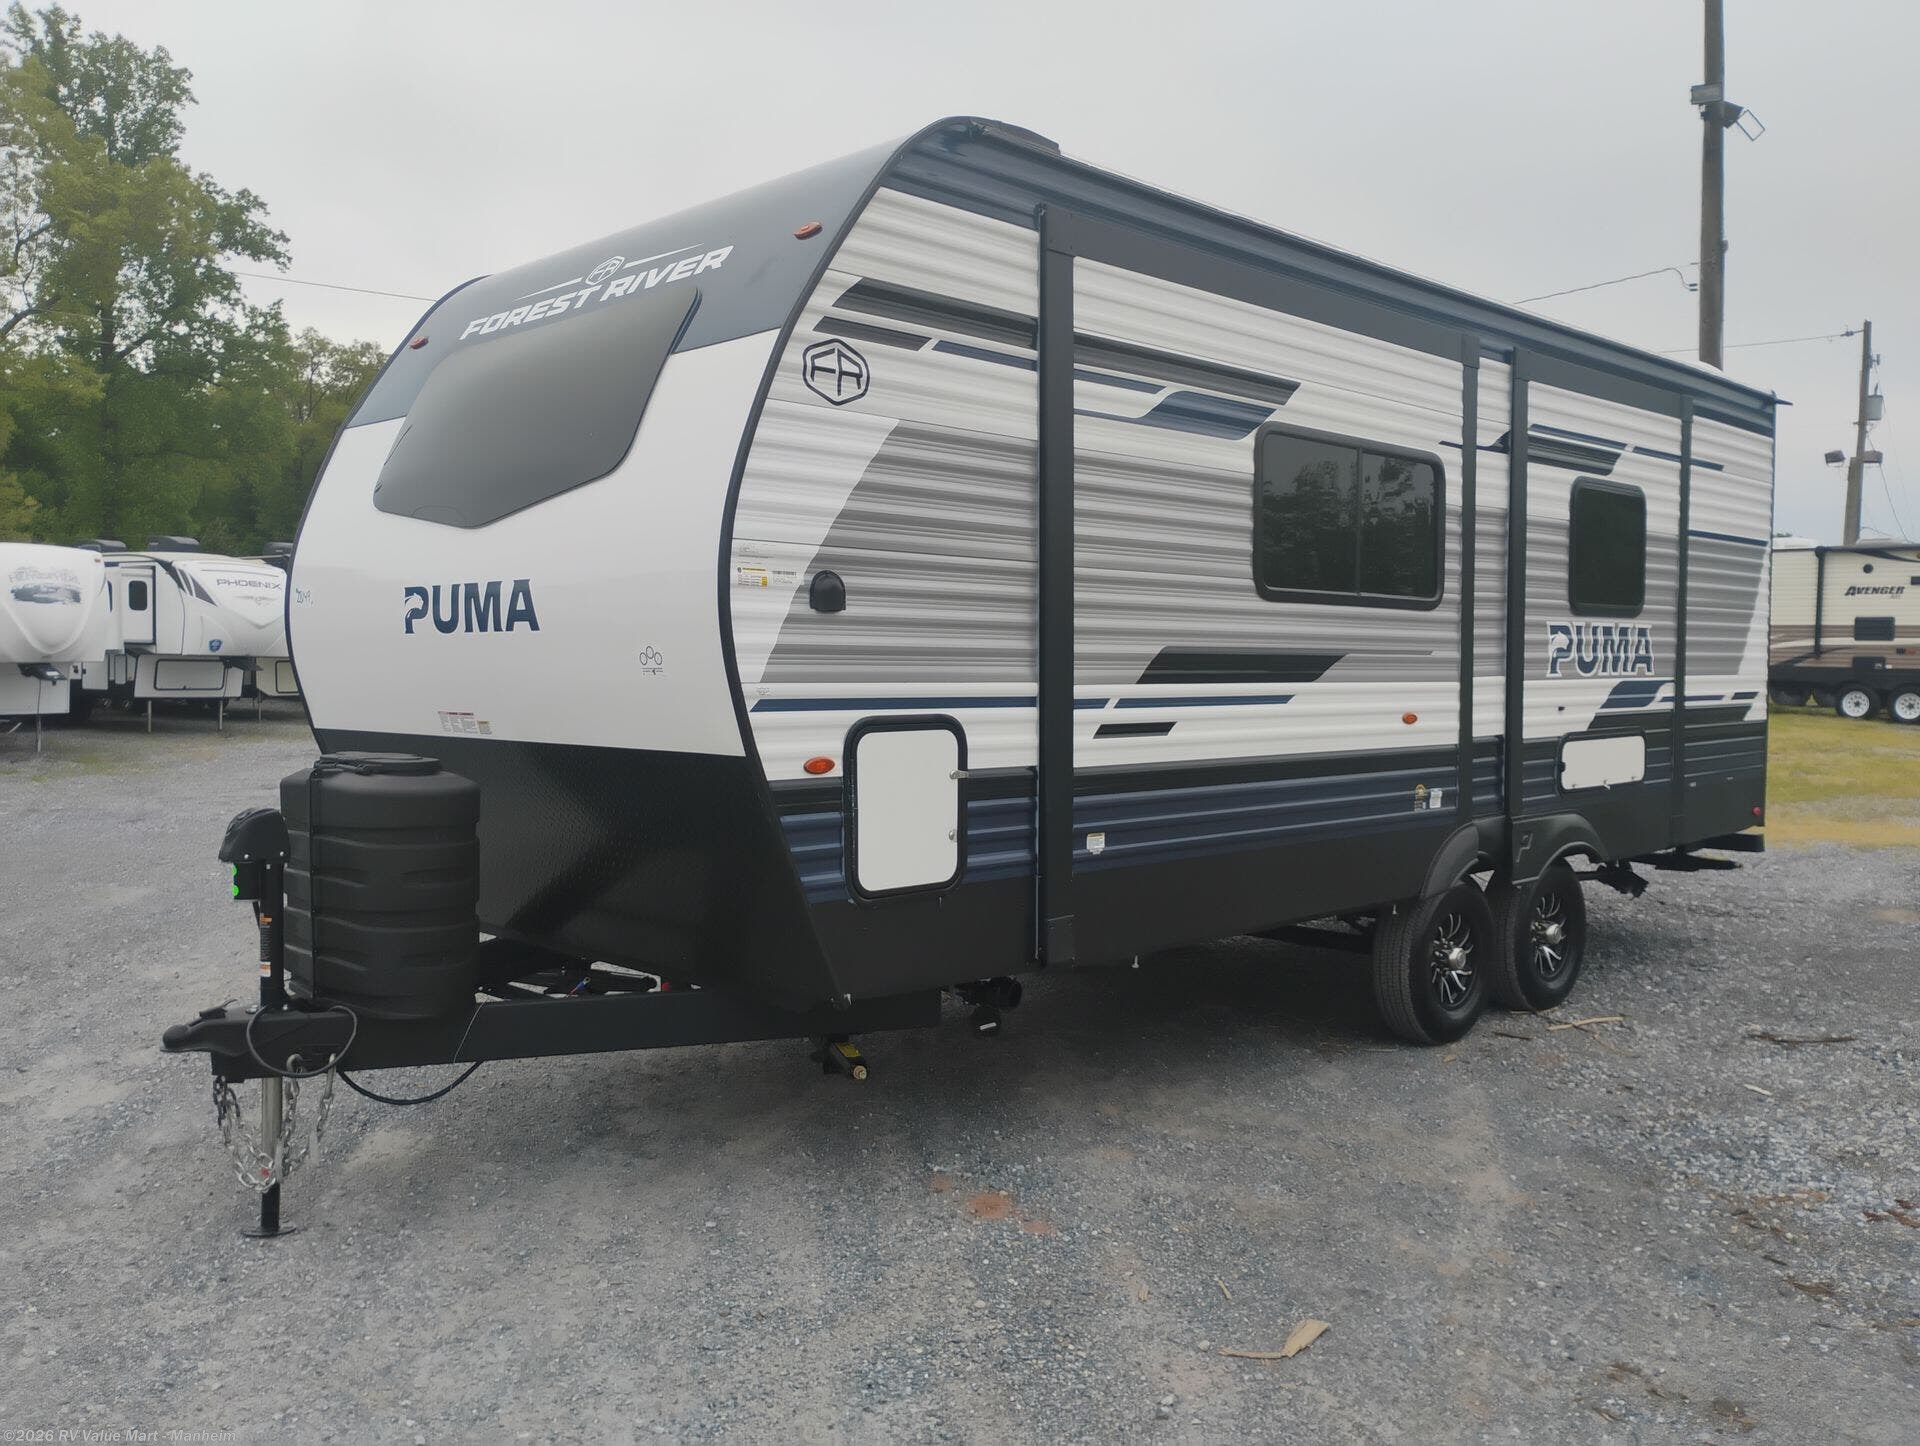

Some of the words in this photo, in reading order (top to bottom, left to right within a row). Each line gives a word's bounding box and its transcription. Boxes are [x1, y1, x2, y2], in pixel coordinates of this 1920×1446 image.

[458, 285, 602, 341] FOREST
[599, 245, 735, 302] RIVER
[216, 578, 281, 589] PHOENIX
[403, 578, 541, 635] PUMA
[1844, 586, 1905, 596] AVENGER
[1546, 621, 1655, 678] PUMA
